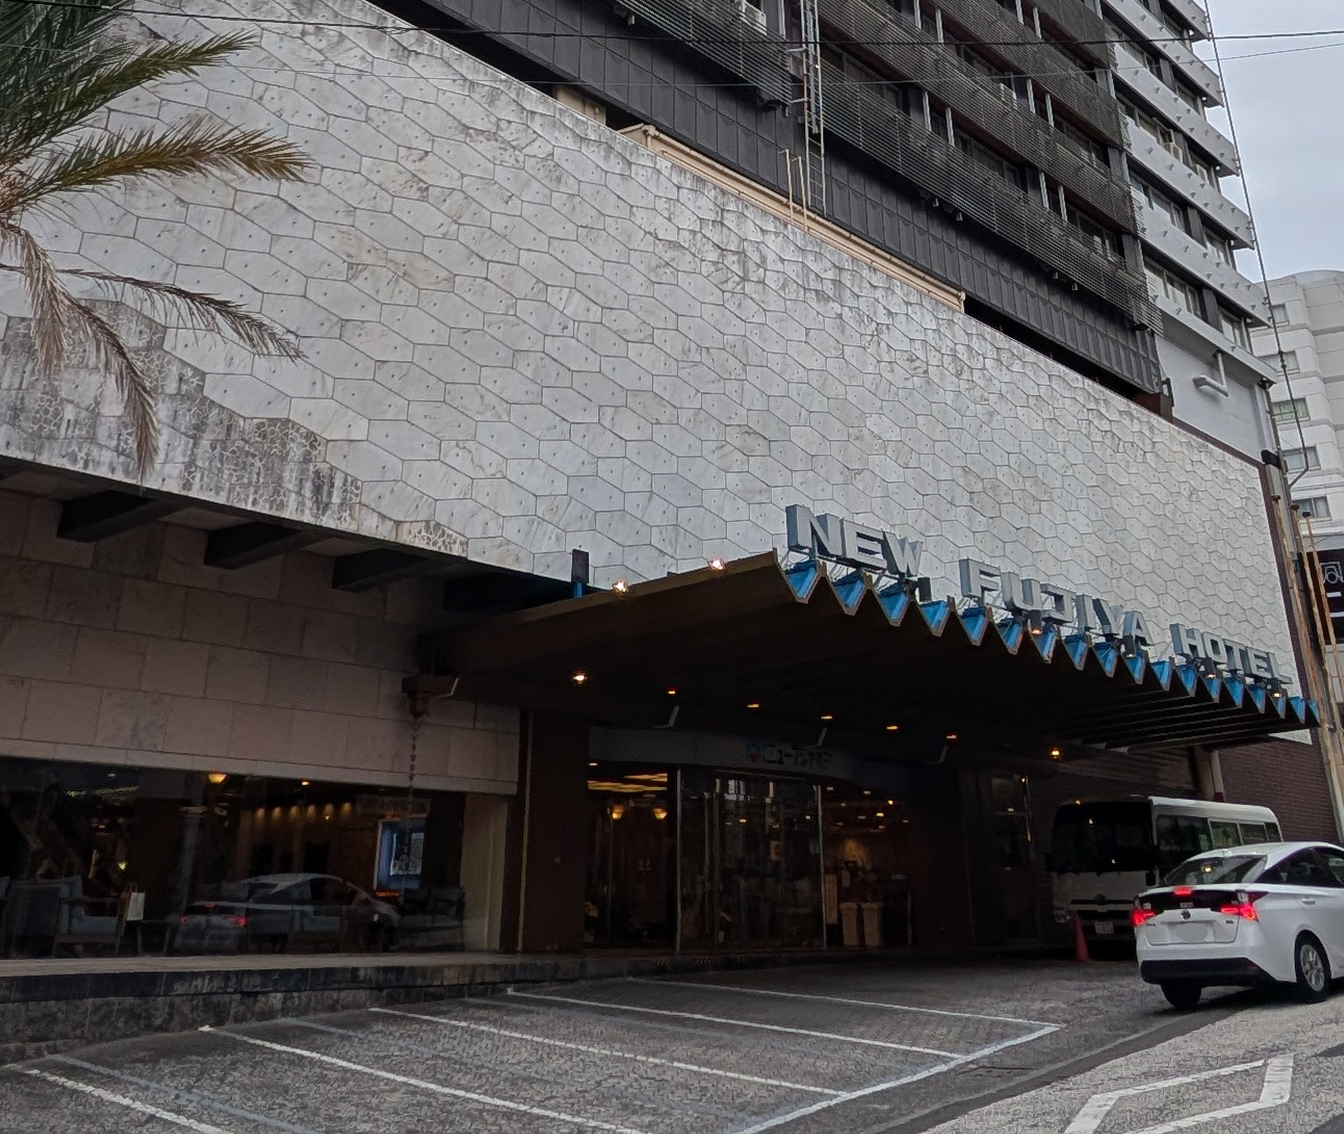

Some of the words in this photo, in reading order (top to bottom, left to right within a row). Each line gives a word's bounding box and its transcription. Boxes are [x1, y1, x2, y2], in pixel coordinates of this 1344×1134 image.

[786, 504, 923, 576] NEW
[959, 558, 1155, 647] FUJIYA
[1169, 623, 1292, 684] HOTEL
